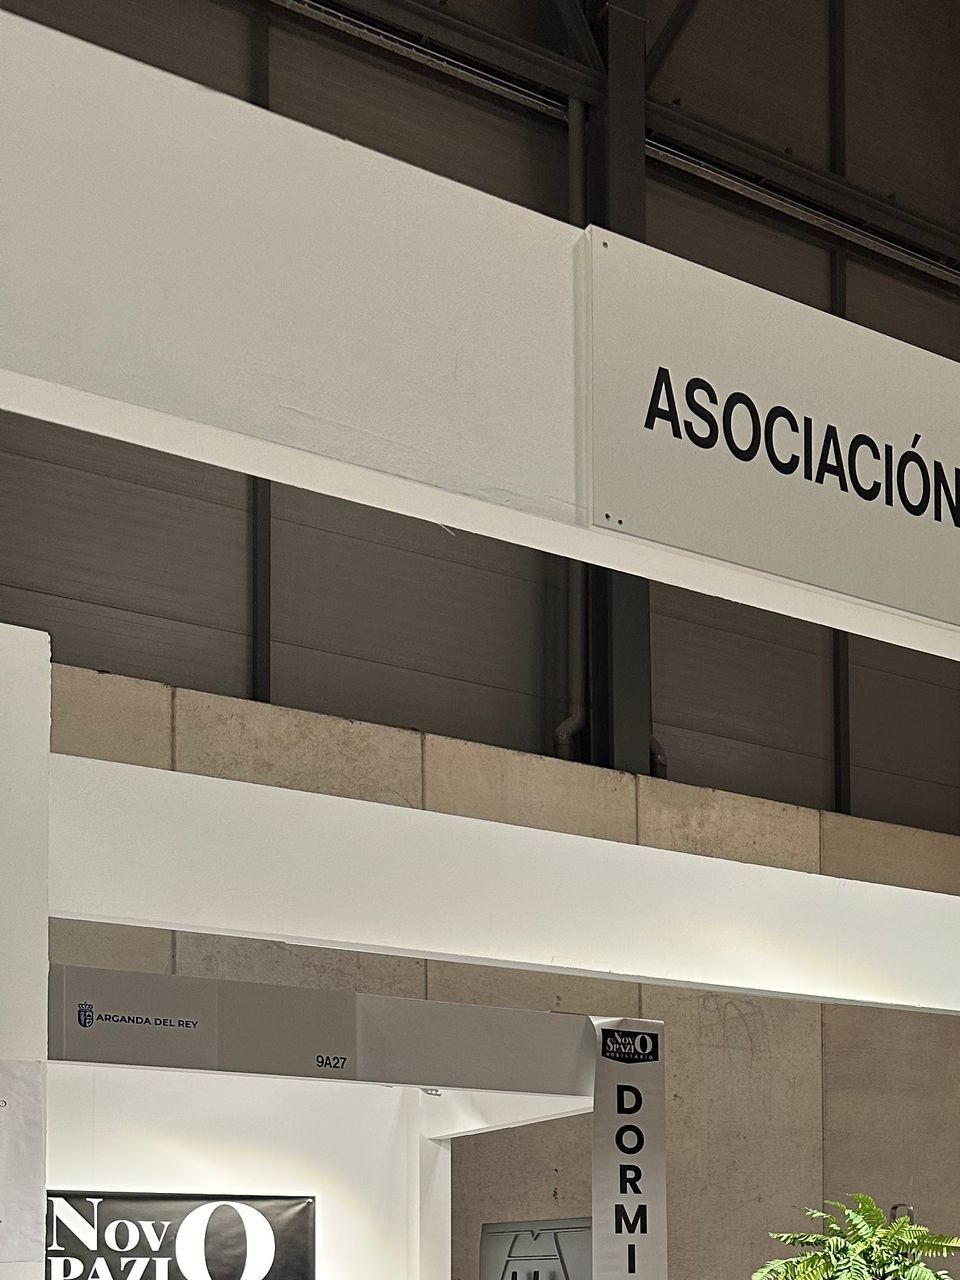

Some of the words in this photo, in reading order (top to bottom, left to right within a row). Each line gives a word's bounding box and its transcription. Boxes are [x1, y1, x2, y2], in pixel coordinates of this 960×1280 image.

[96, 1013, 151, 1025] ARGANDA
[154, 1017, 176, 1028] DEL
[178, 1019, 199, 1029] REY
[316, 1054, 348, 1070] 9A27
